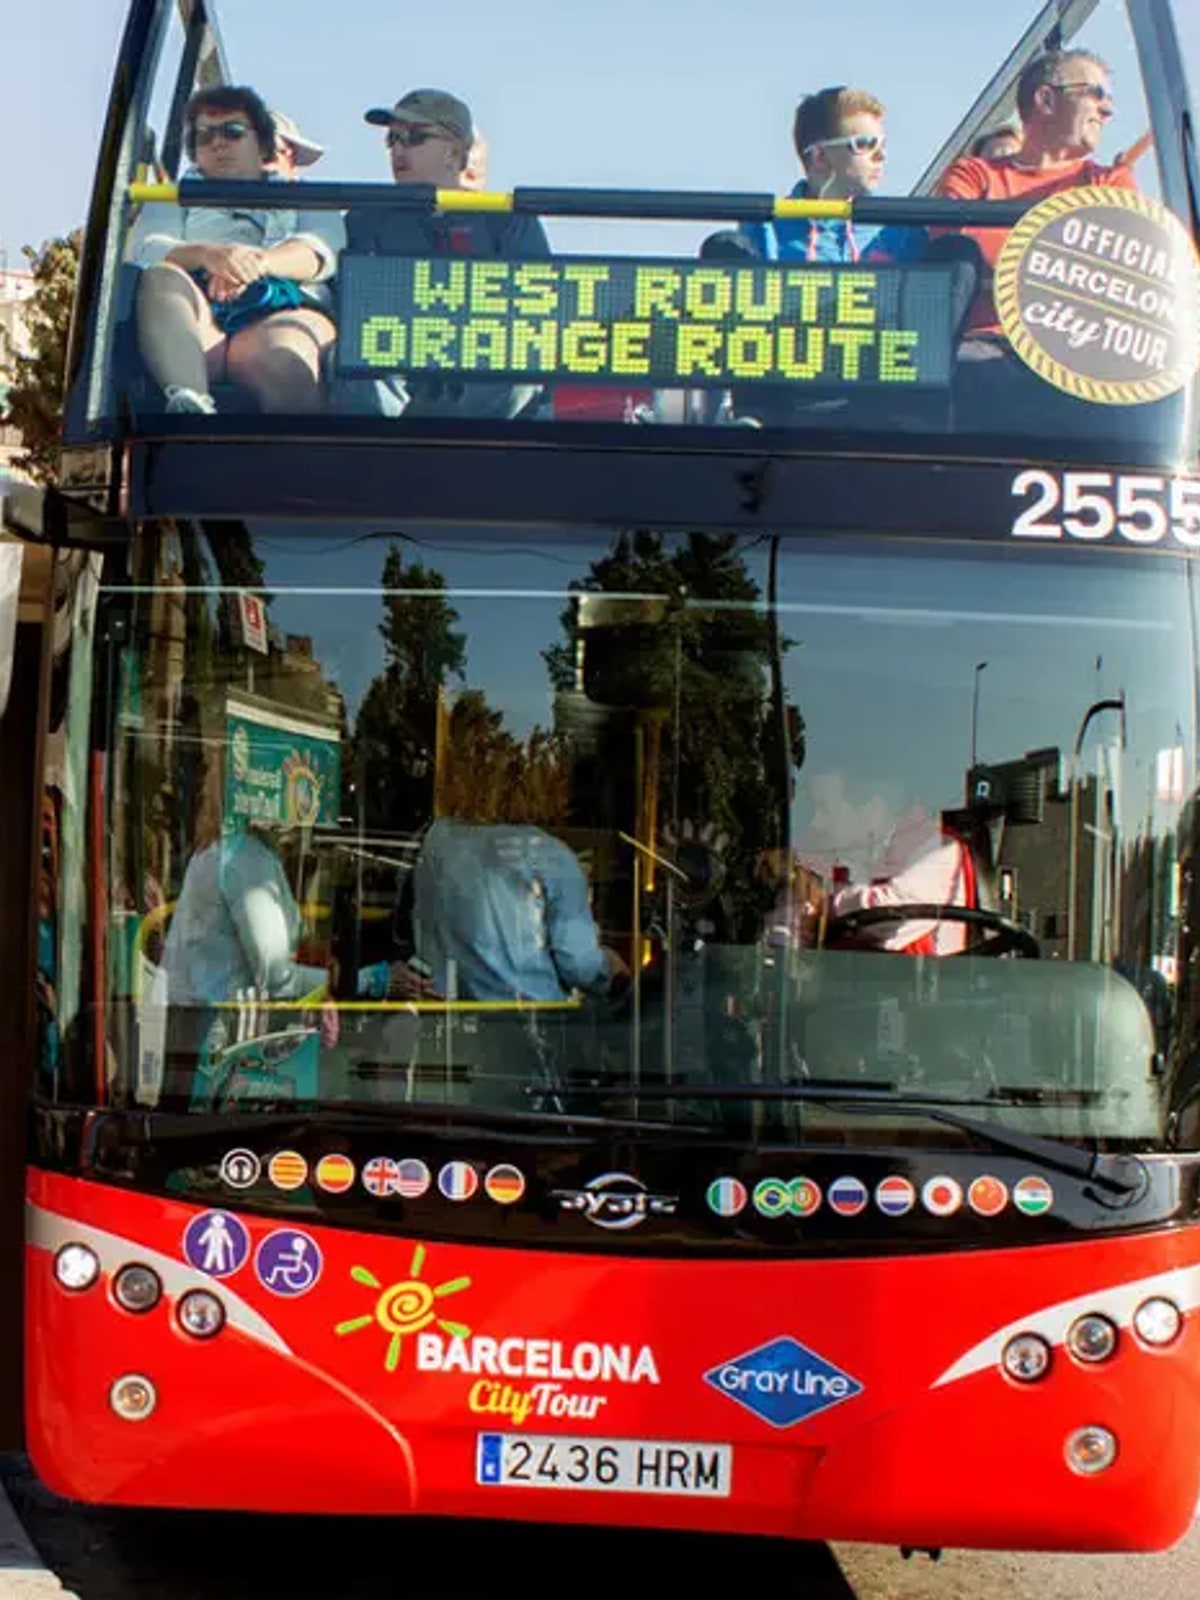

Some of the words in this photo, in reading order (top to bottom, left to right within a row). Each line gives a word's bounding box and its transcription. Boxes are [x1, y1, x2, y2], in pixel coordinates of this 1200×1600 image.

[1063, 217, 1177, 282] OFFICIAL
[412, 260, 609, 317] WEST
[634, 267, 877, 324] ROUTE
[1028, 251, 1178, 323] BARCELON
[360, 315, 652, 375] ORANGE
[675, 323, 919, 382] ROUTE
[1023, 301, 1101, 349] city
[1102, 317, 1169, 371] TOUR
[1011, 469, 1200, 546] 2555
[417, 1333, 661, 1384] BARCELONA
[508, 1440, 620, 1484] 2436
[636, 1447, 720, 1489] HRM
